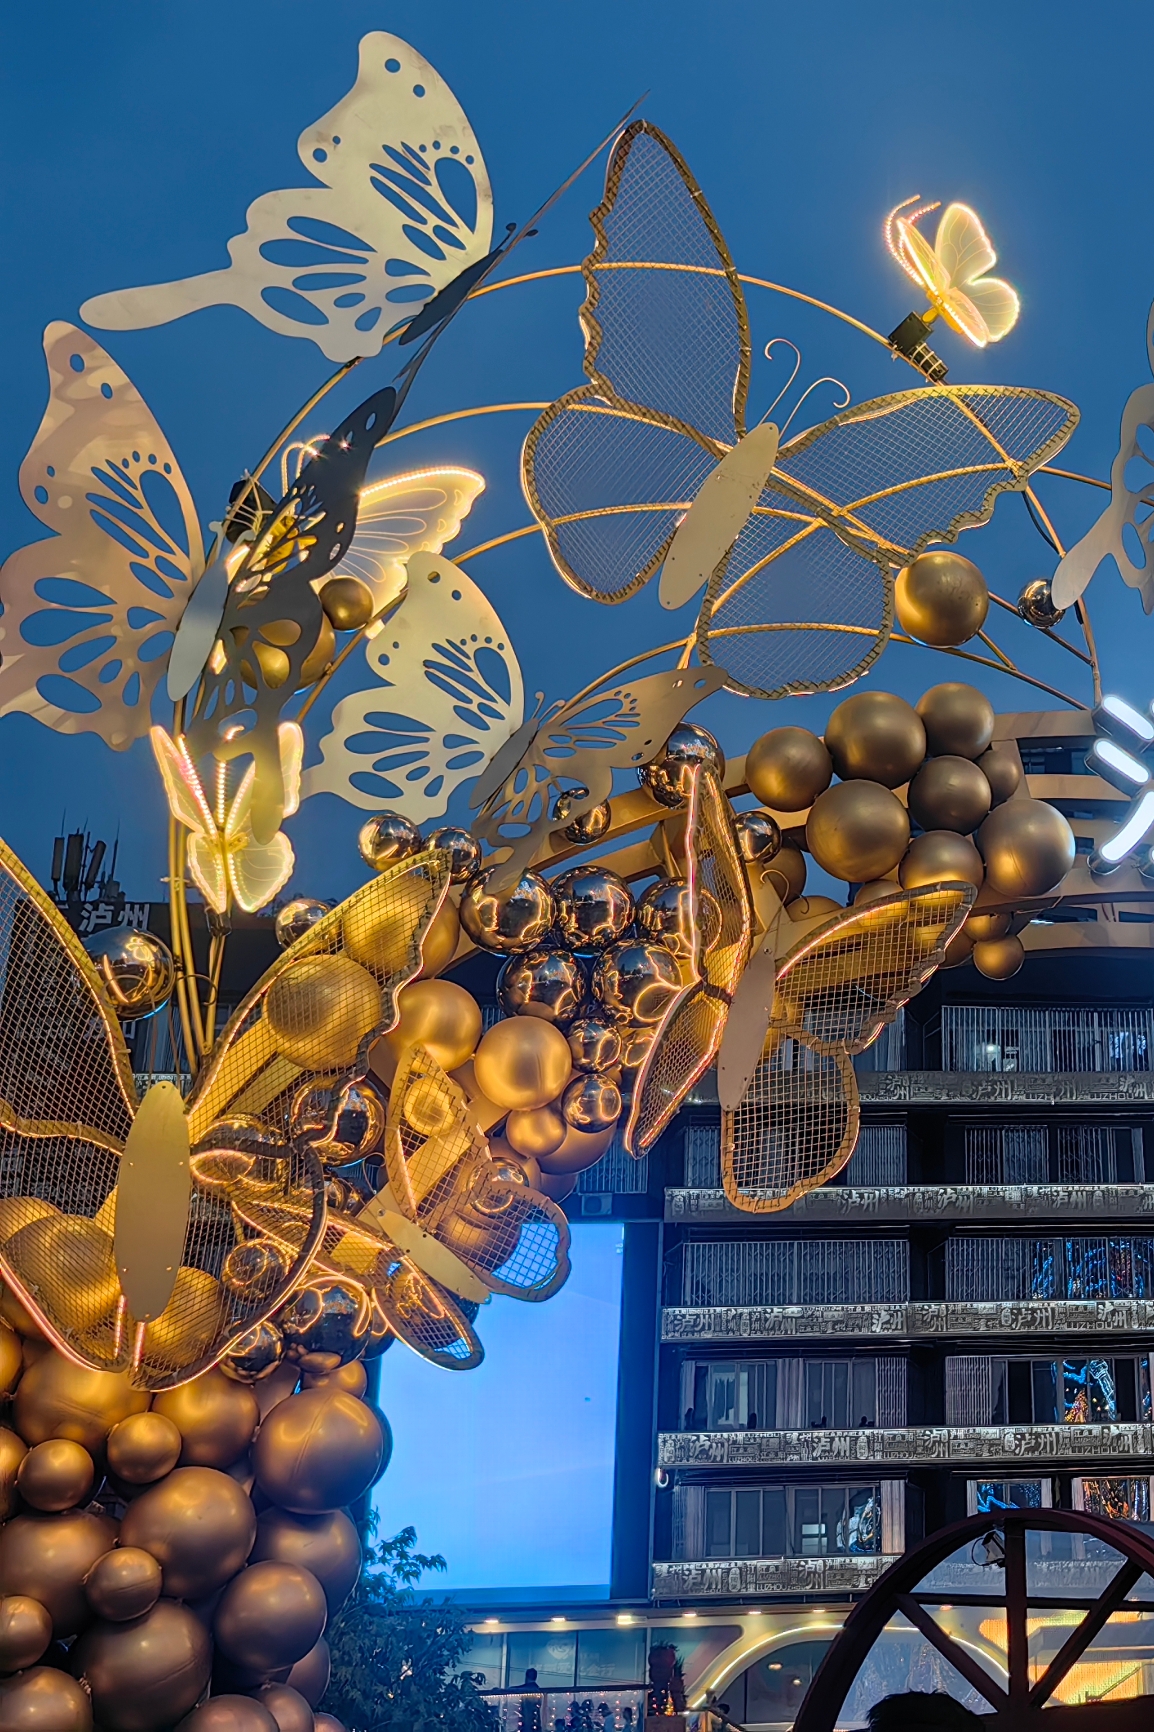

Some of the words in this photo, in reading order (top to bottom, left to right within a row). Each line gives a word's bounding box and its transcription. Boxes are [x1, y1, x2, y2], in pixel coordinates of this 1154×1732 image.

[674, 1314, 714, 1332] 泸州
[1011, 1303, 1053, 1331] 泸州
[1066, 1321, 1114, 1330] LUZHOU
[812, 1436, 850, 1458] 泸州
[924, 1428, 949, 1458] 泸州
[1014, 1431, 1057, 1456] 泸州
[1069, 1445, 1119, 1454] LUZHOU
[683, 1568, 722, 1591] 泸州
[799, 1559, 824, 1589] 泸州
